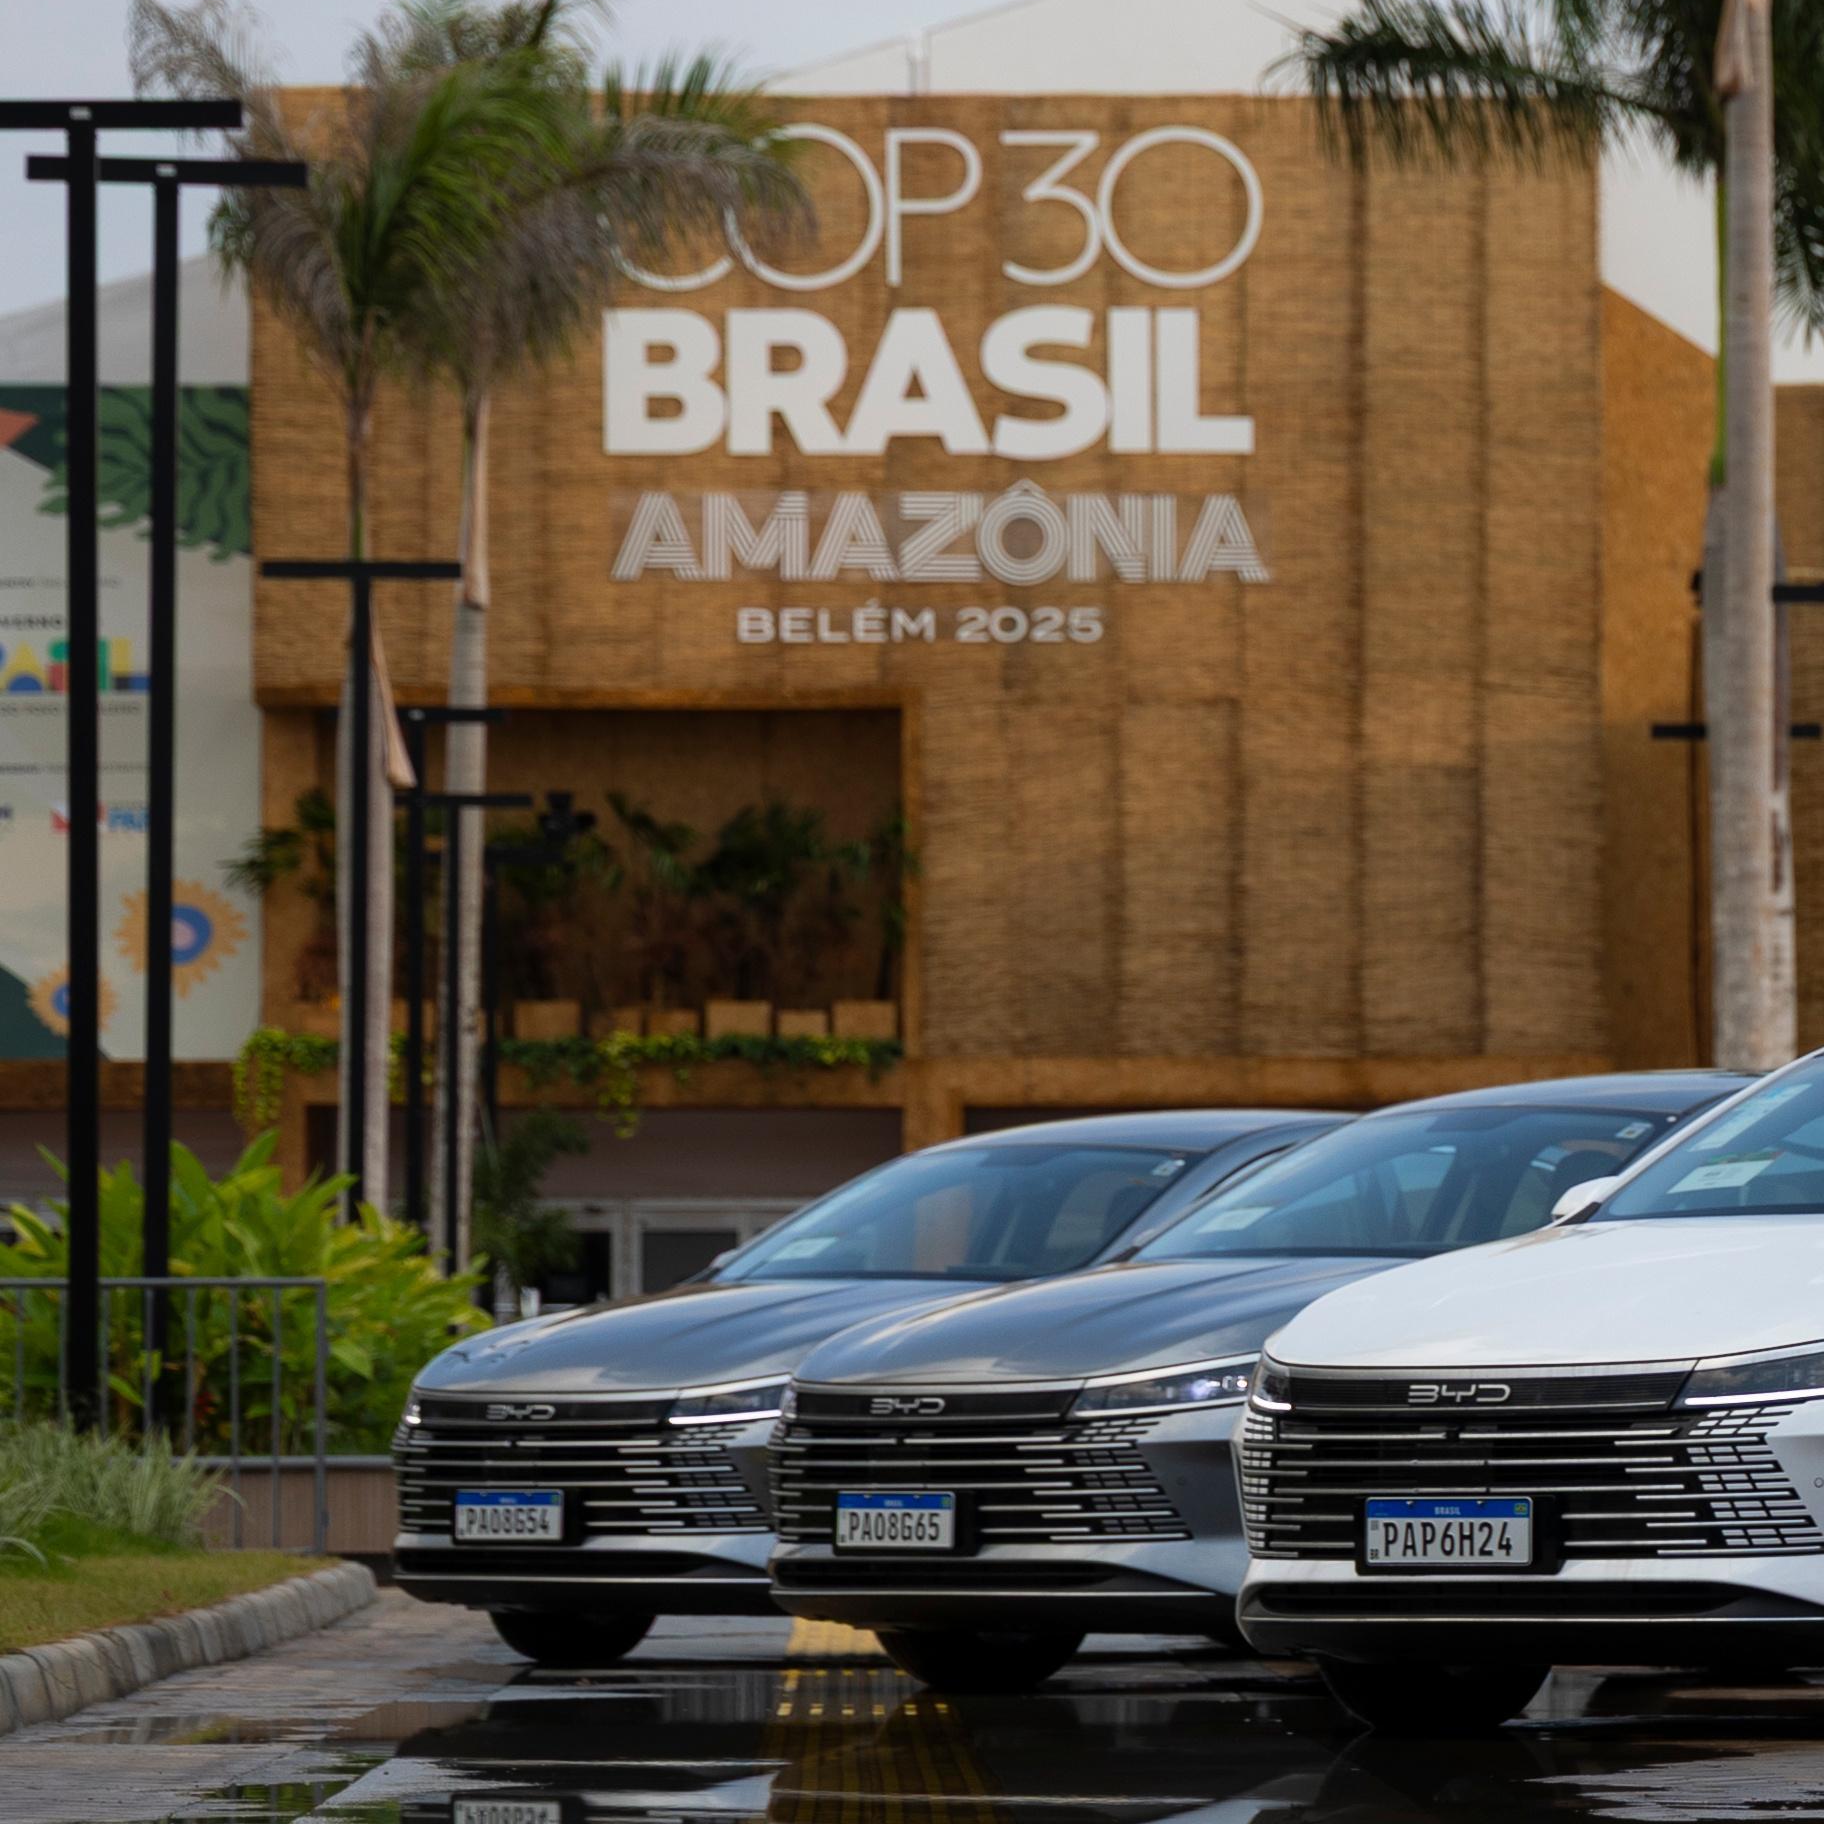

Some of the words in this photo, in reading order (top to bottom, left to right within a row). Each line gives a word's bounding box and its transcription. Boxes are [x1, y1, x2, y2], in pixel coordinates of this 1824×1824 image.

[1000, 123, 1264, 289] 30
[604, 304, 1255, 460] BRASIL
[611, 479, 1272, 585] AMAZÔNIA
[736, 600, 937, 645] BELÉM
[955, 607, 1105, 645] 2025
[869, 1396, 946, 1416] BYD
[1407, 1383, 1511, 1404] BYD
[1383, 1521, 1513, 1558] PAP6H24
